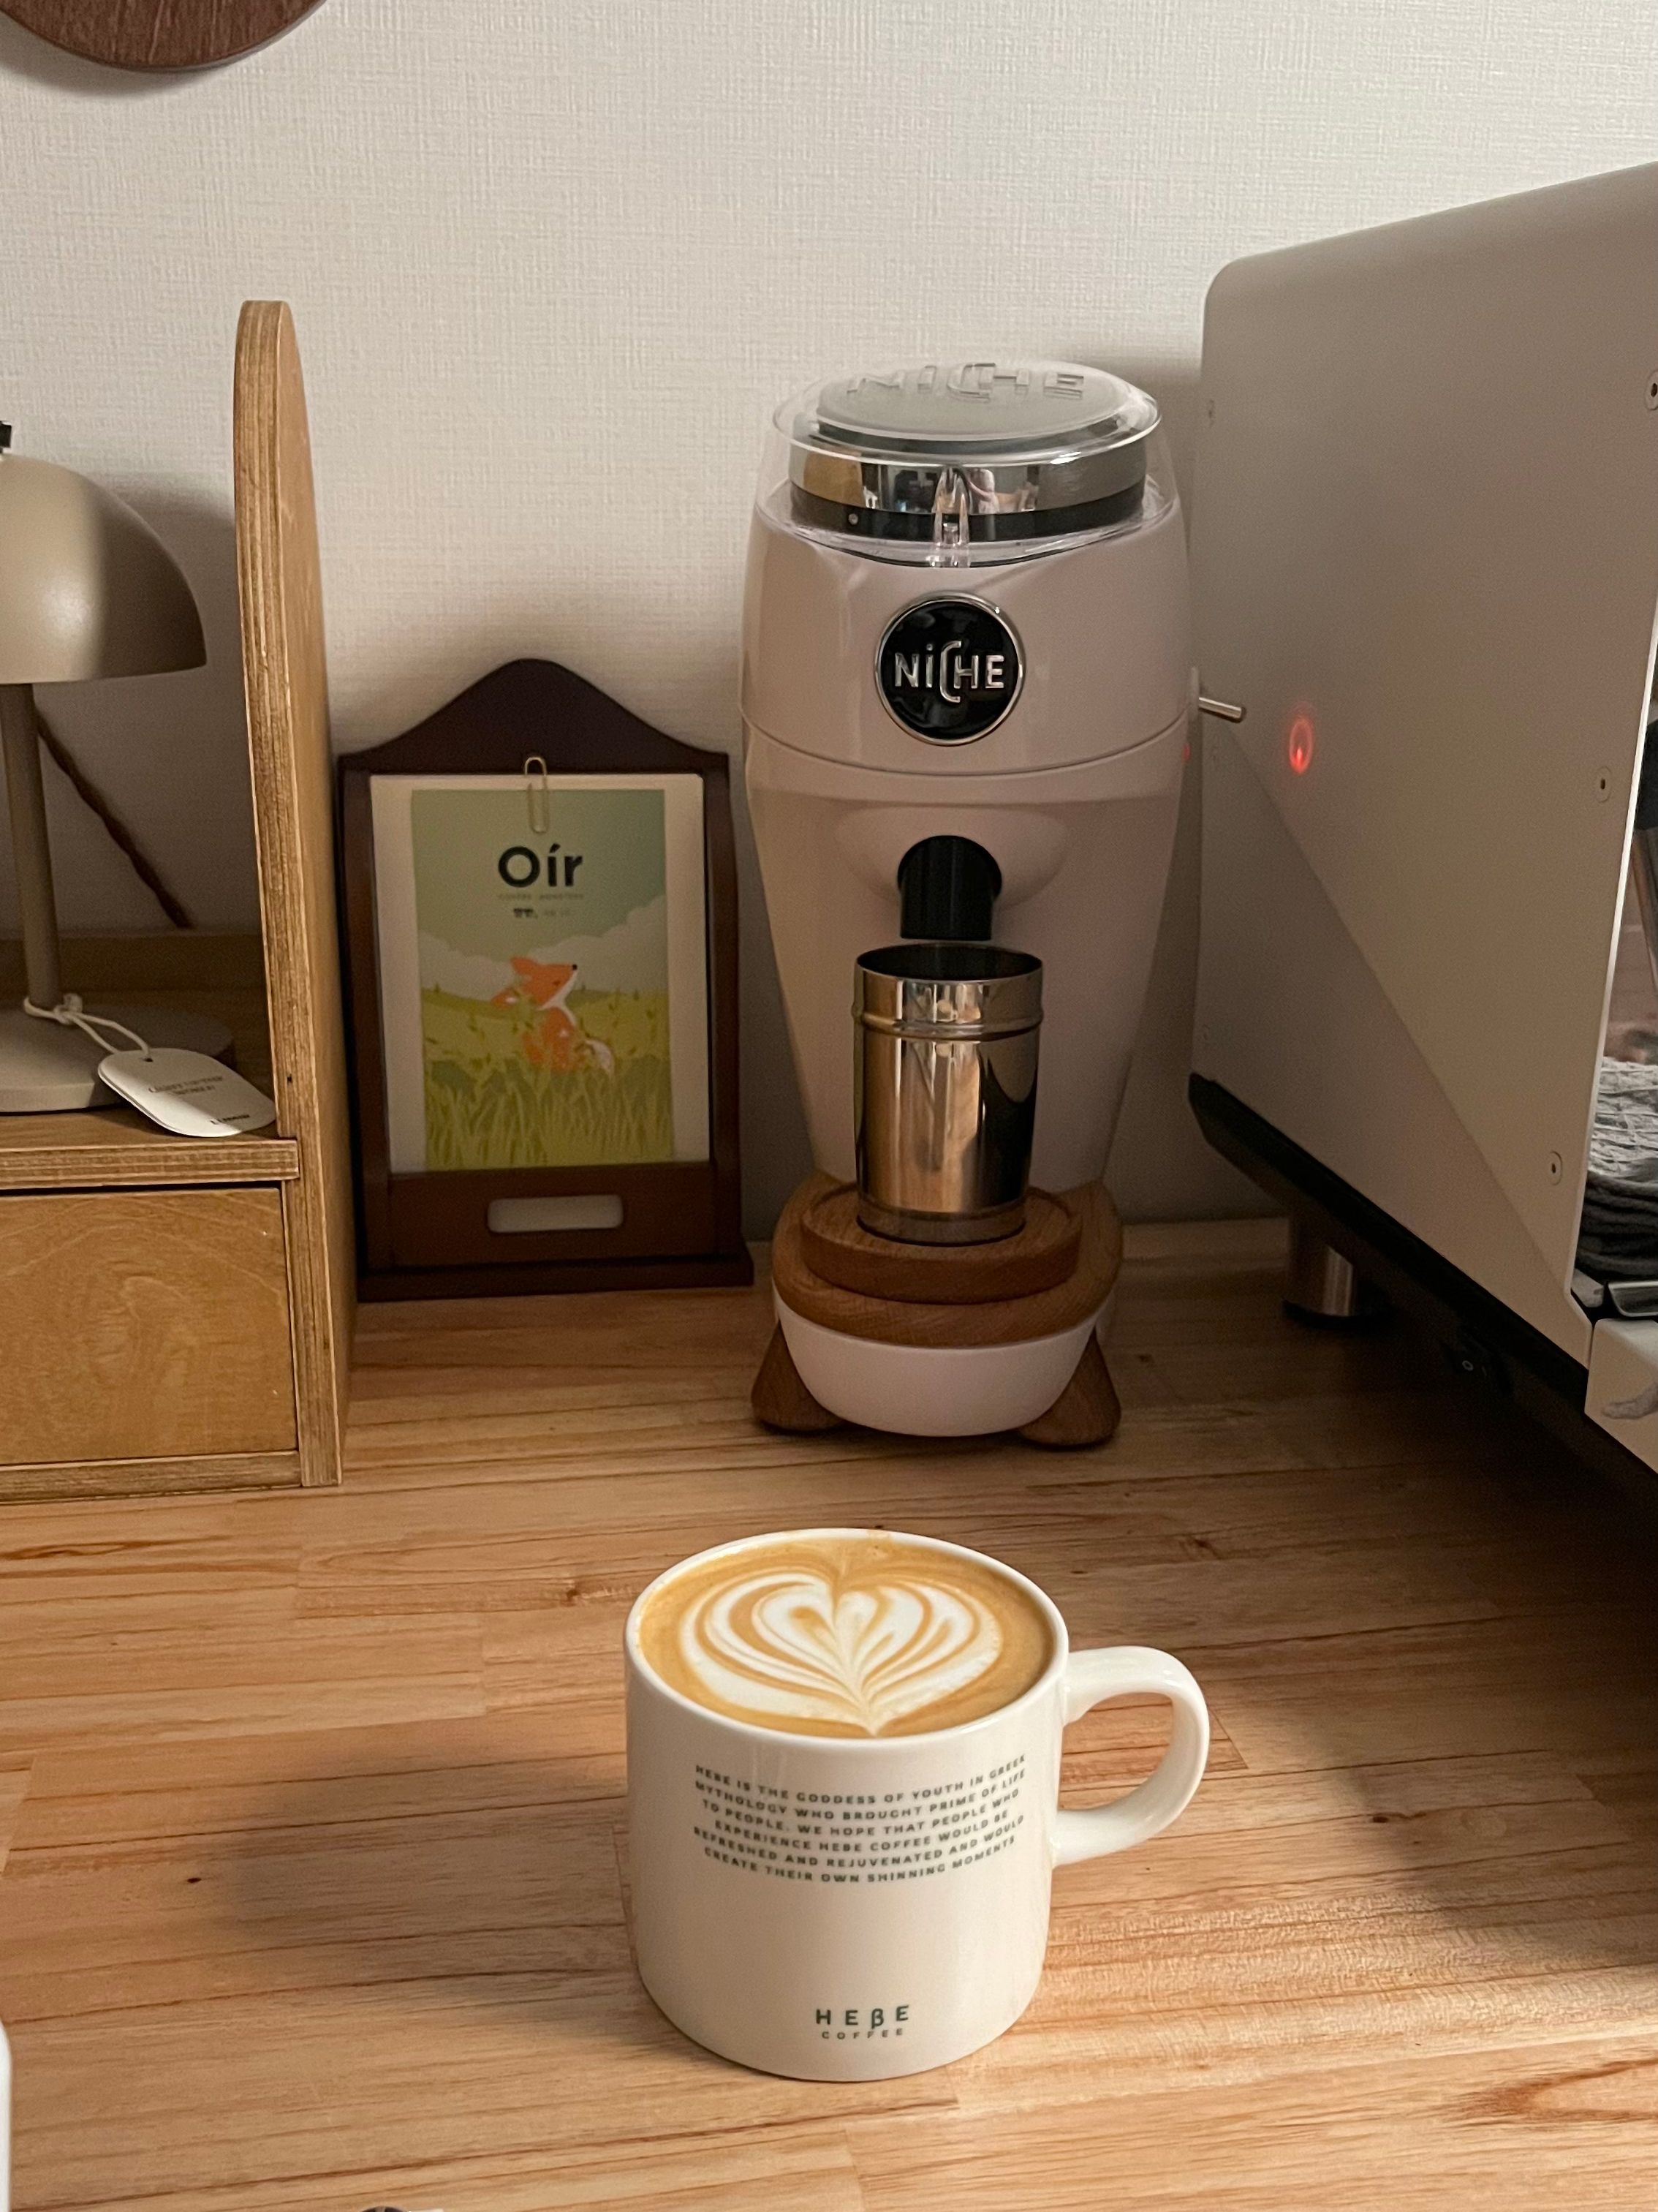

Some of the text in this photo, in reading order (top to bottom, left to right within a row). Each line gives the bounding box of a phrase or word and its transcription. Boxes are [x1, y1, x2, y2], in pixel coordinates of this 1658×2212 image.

[498, 843, 583, 888] Oír
[695, 1768, 1025, 1820] MYTHOLOGY WHO BROUGHT PRIME OF LIFE
[696, 1754, 1025, 1804] HEBE IS THE GODDESS OF YOUTH IN GREEK
[703, 1799, 719, 1813] TO
[797, 1825, 822, 1835] WE
[830, 1827, 875, 1835] HOPE
[884, 1822, 924, 1835] THAT
[932, 1804, 986, 1828] PEOPLE
[992, 1788, 1018, 1808] WHO
[715, 1809, 1007, 1851] EXPERIENCE HEBE COFFEE WOULD BE
[694, 1815, 1024, 1867] REFRESHED AND REJUVENATED AND WOULD
[705, 1835, 1014, 1882] CREATE THEIR OWN SHINNING MOMENTS
[822, 2028, 903, 2039] COFFEE
